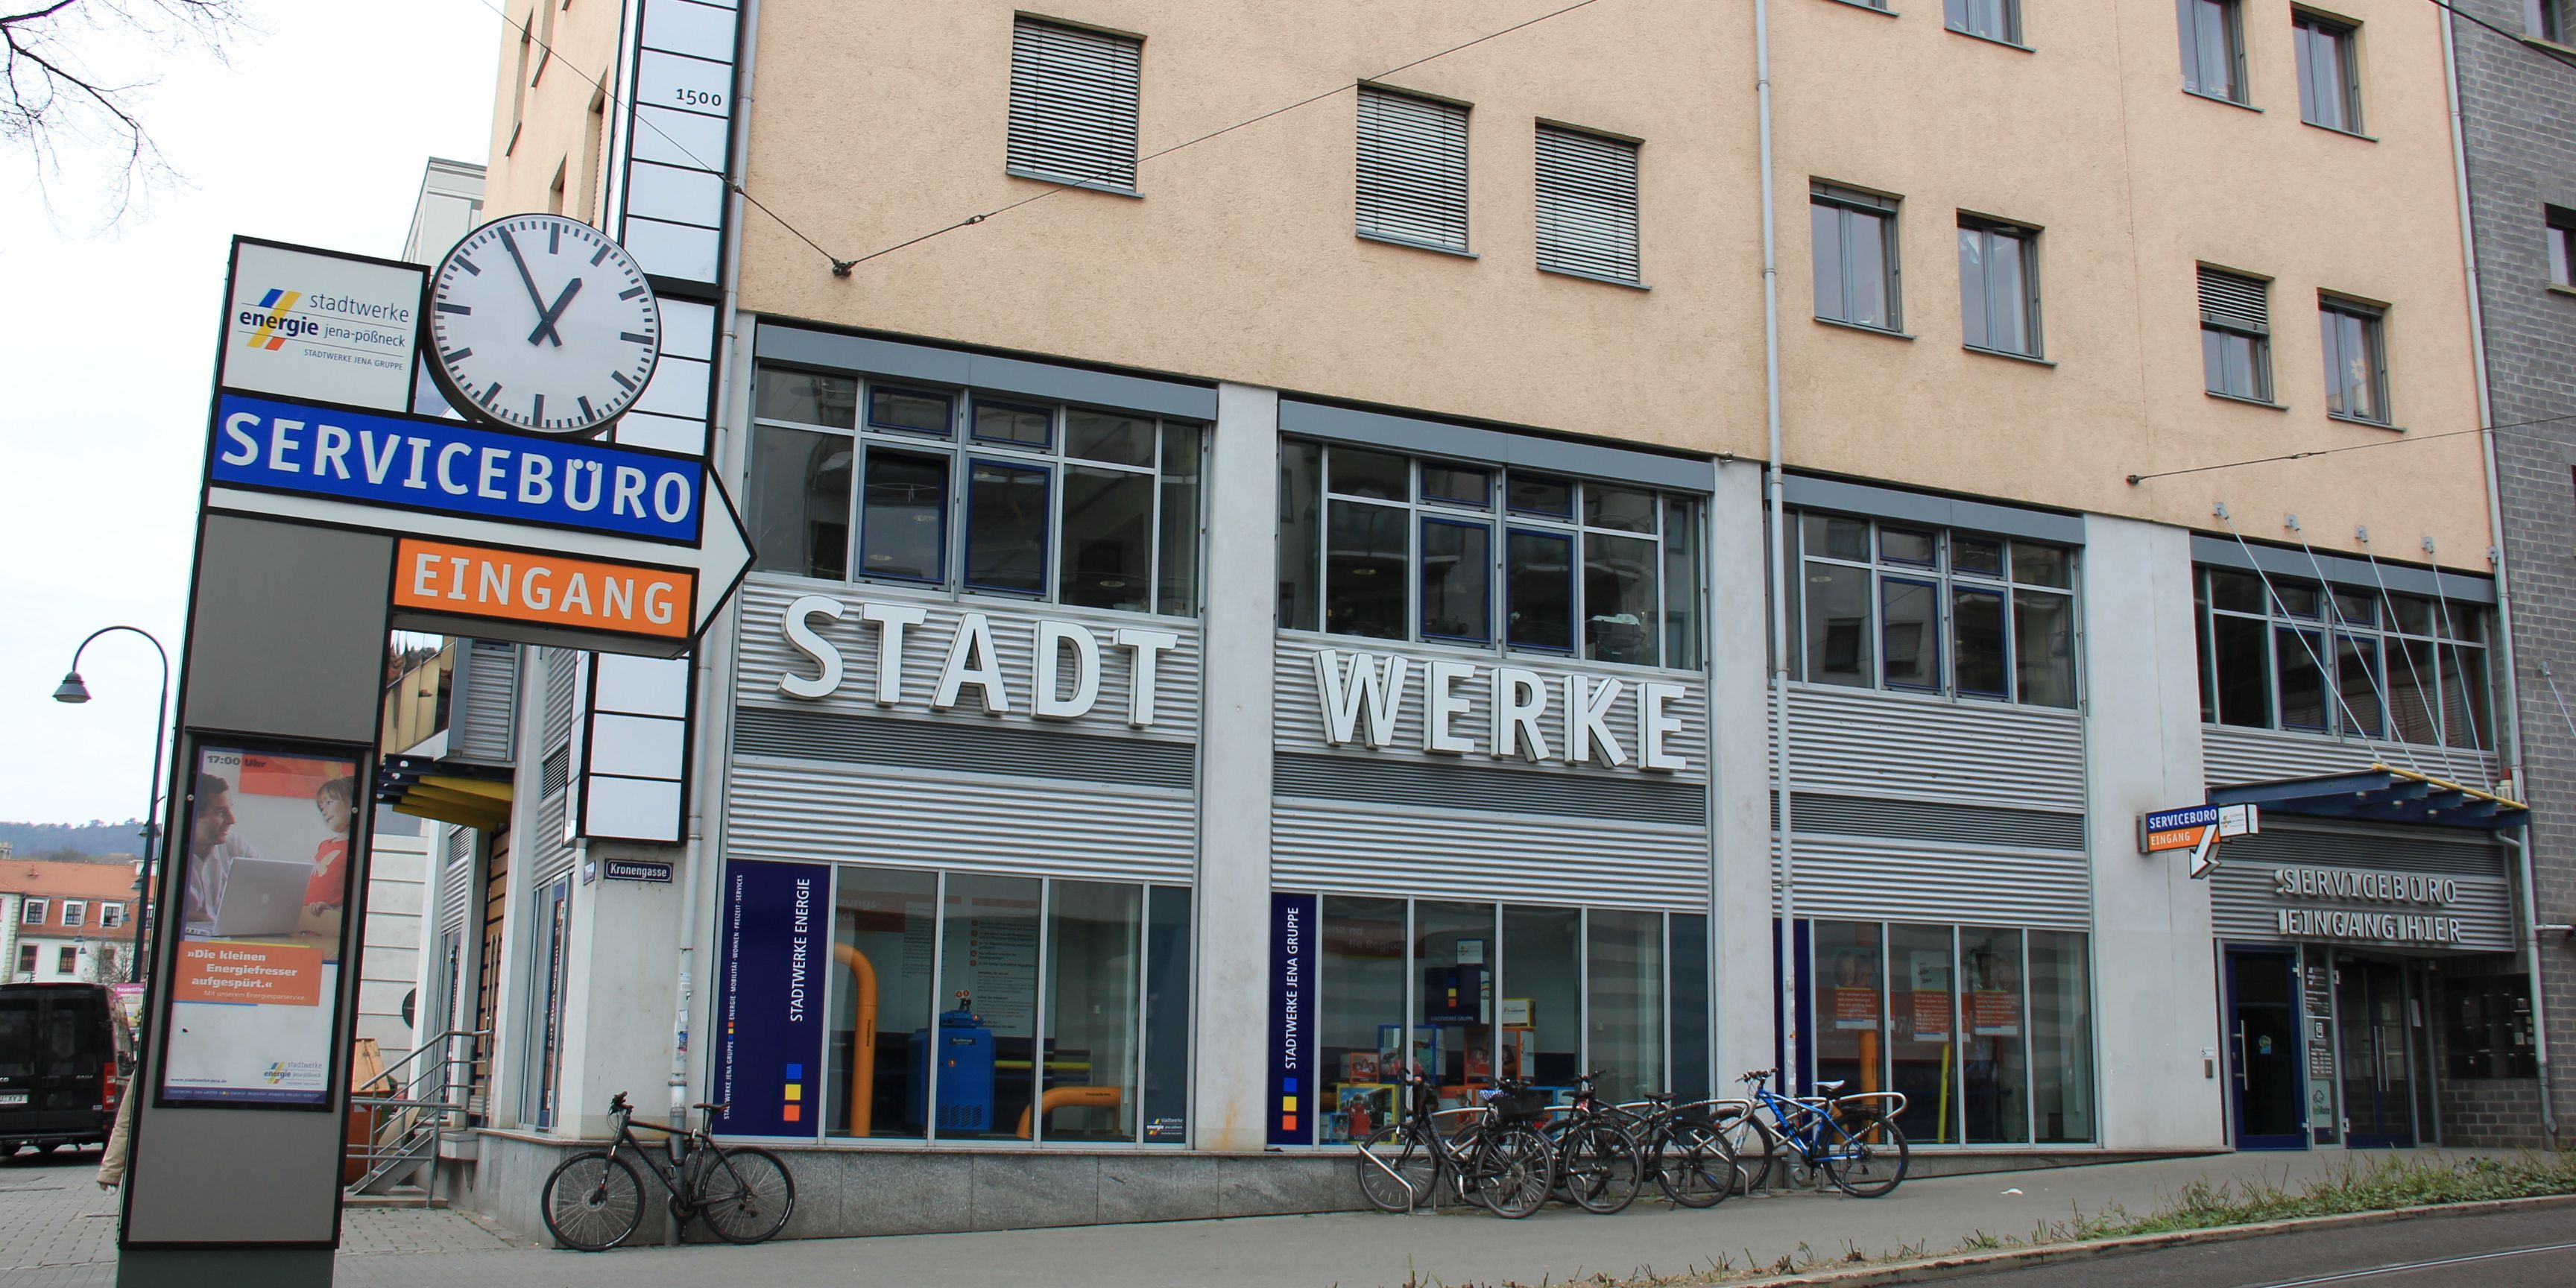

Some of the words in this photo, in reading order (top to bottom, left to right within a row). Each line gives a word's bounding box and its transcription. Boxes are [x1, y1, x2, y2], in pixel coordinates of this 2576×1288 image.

[676, 88, 722, 106] 1500
[309, 294, 409, 323] stadtwerke
[239, 311, 319, 336] energie
[323, 323, 405, 347] jena-pößneck
[304, 348, 352, 363] STADTWERKE
[353, 356, 372, 366] JENA
[374, 359, 403, 370] GRUPPE
[221, 411, 692, 523] SERVICEBÜRO
[413, 552, 674, 626] EINGANG
[777, 594, 1179, 727] STADT
[1312, 648, 1688, 771] WERKE
[207, 755, 240, 765] 17:00
[244, 757, 266, 768] Uhr
[2150, 831, 2191, 846] EINGANG
[610, 862, 667, 880] Kronengasse
[735, 874, 743, 901] SERVICES
[2277, 868, 2457, 904] SERVICEBÜRO
[795, 878, 810, 933] ENERGIE
[1287, 906, 1299, 955] GRUPPE
[2282, 909, 2394, 939] EINGANG
[2402, 915, 2460, 942] HIER
[187, 949, 215, 959] »Die
[219, 950, 266, 962] kleinen
[206, 963, 298, 976] Energiefresser
[192, 976, 274, 989] aufgespürt.«
[730, 962, 738, 992] MOBILITÄT
[790, 936, 807, 1022] STADTWERKE
[1286, 957, 1298, 988] JENA
[246, 991, 307, 1001] Energiesparservice.
[728, 995, 736, 1020] ENERGIE
[1285, 990, 1298, 1070] STADTWERKE
[264, 1069, 291, 1079] energie
[723, 1082, 731, 1120] STAWERKE
